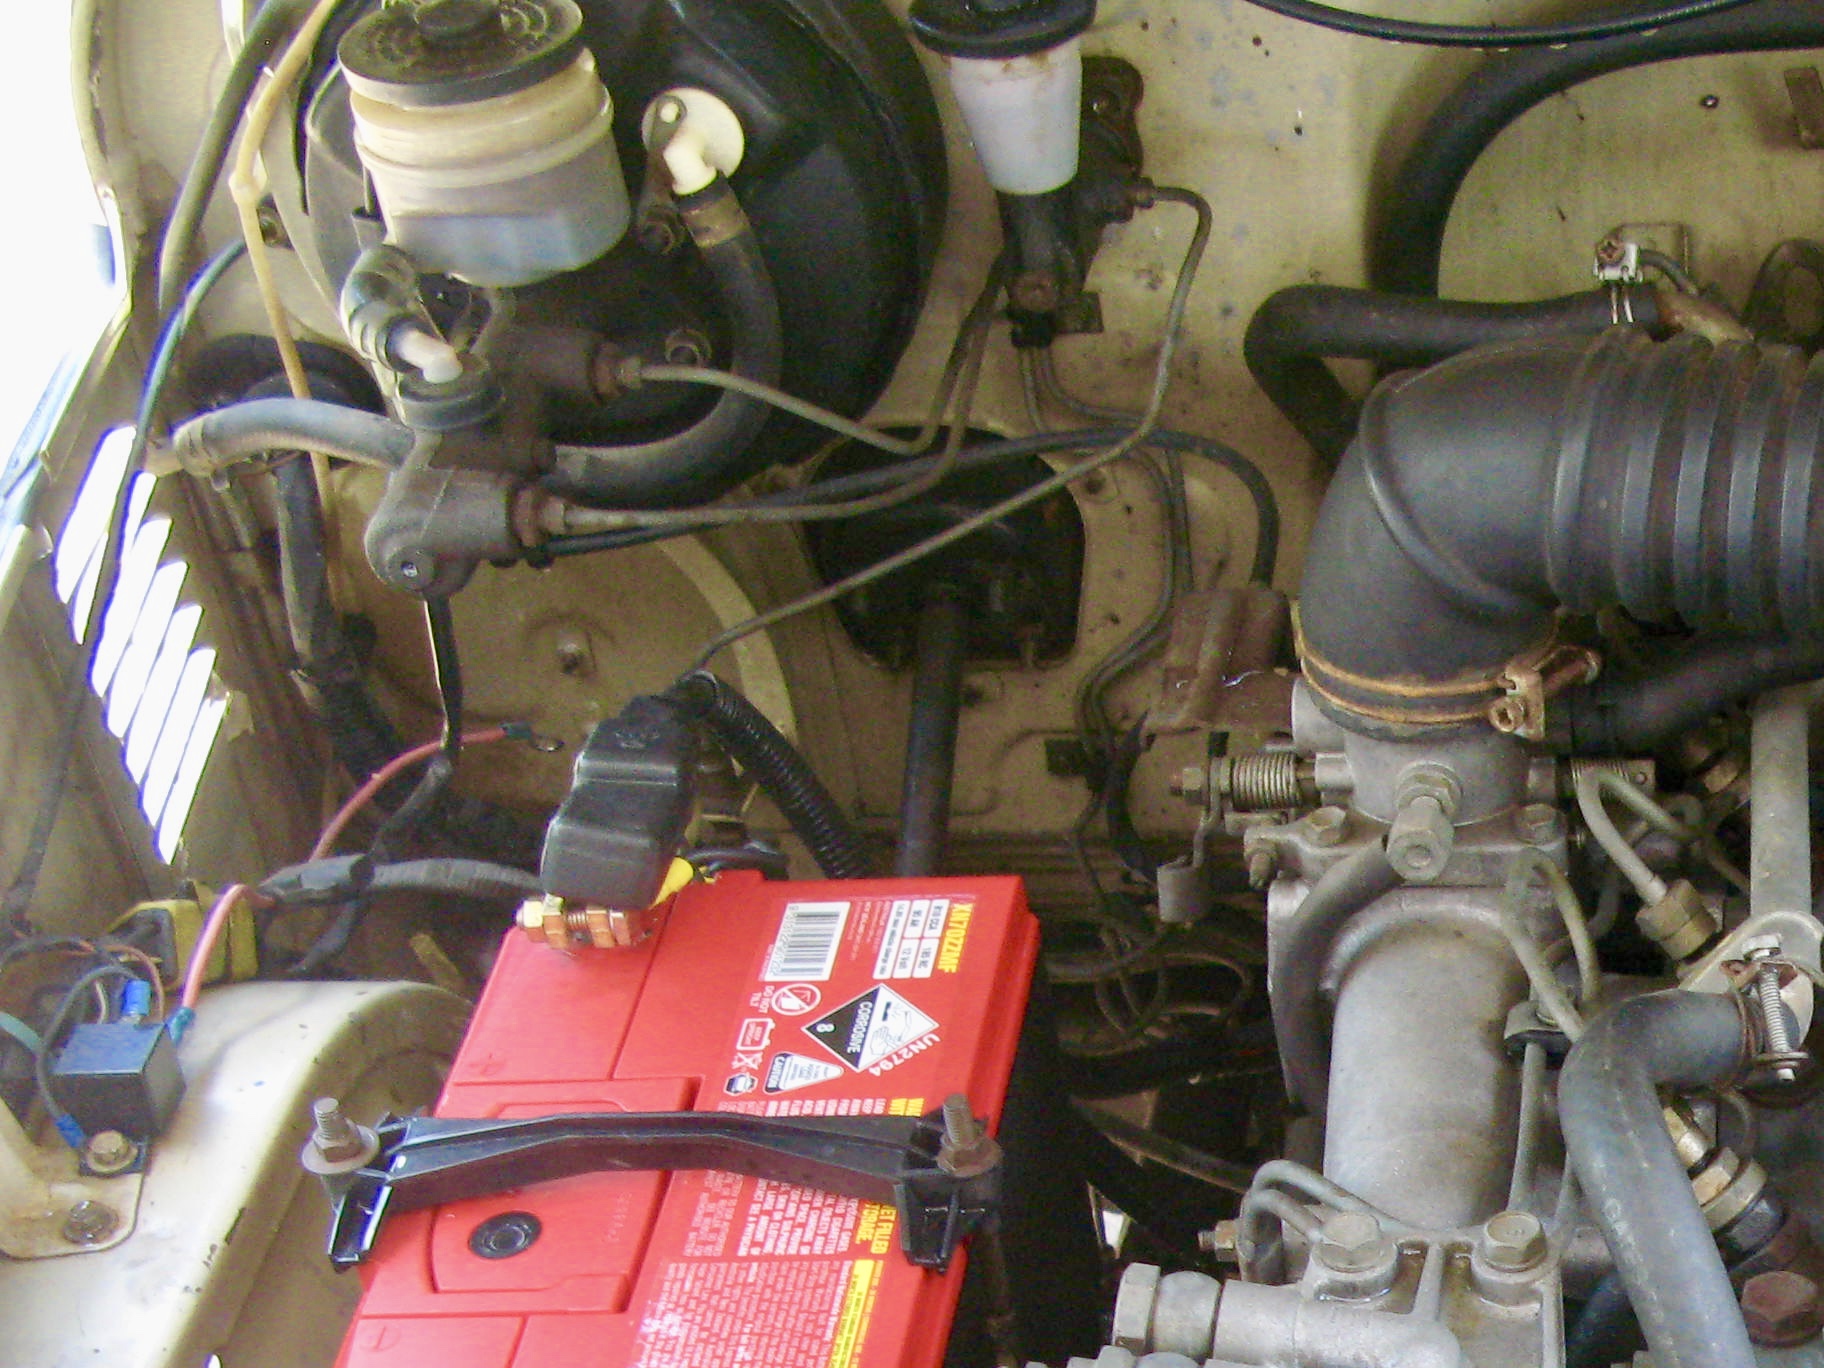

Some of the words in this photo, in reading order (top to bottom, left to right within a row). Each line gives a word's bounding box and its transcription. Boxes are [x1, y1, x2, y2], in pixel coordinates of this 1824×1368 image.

[937, 902, 974, 973] XN70ZZMF
[815, 1022, 835, 1033] 8
[846, 1001, 873, 1054] CORROSIVE
[767, 1056, 786, 1088] CAUTION
[867, 1032, 941, 1077] UN2794
[855, 1203, 880, 1244] TORAGE.
[880, 1205, 897, 1221] ET
[870, 1222, 894, 1254] FILLED
